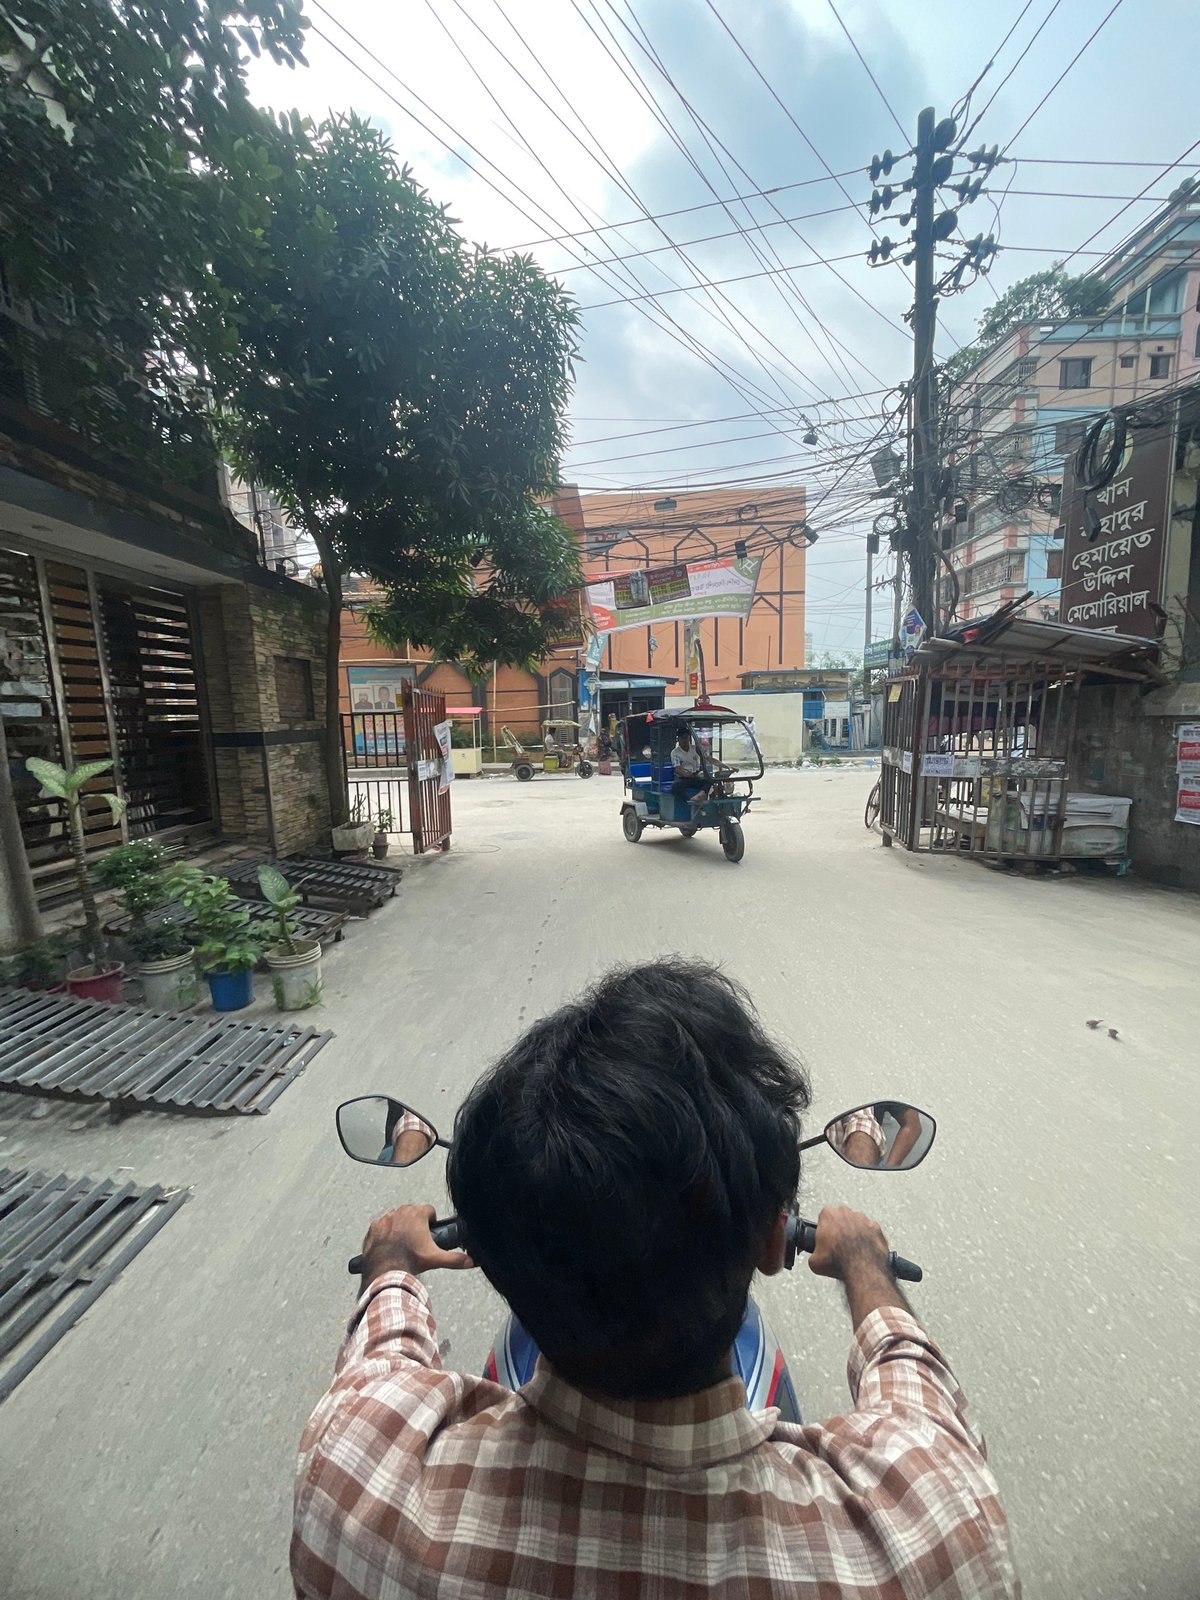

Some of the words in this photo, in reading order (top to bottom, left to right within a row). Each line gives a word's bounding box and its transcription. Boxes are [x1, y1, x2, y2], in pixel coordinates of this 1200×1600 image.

[1096, 477, 1134, 506] খান
[1079, 500, 1148, 537] হাদুর
[1072, 528, 1156, 571] হেমায়েত
[1083, 565, 1135, 593] উদ্দিন
[1067, 590, 1150, 623] মেমোরিয়াল
